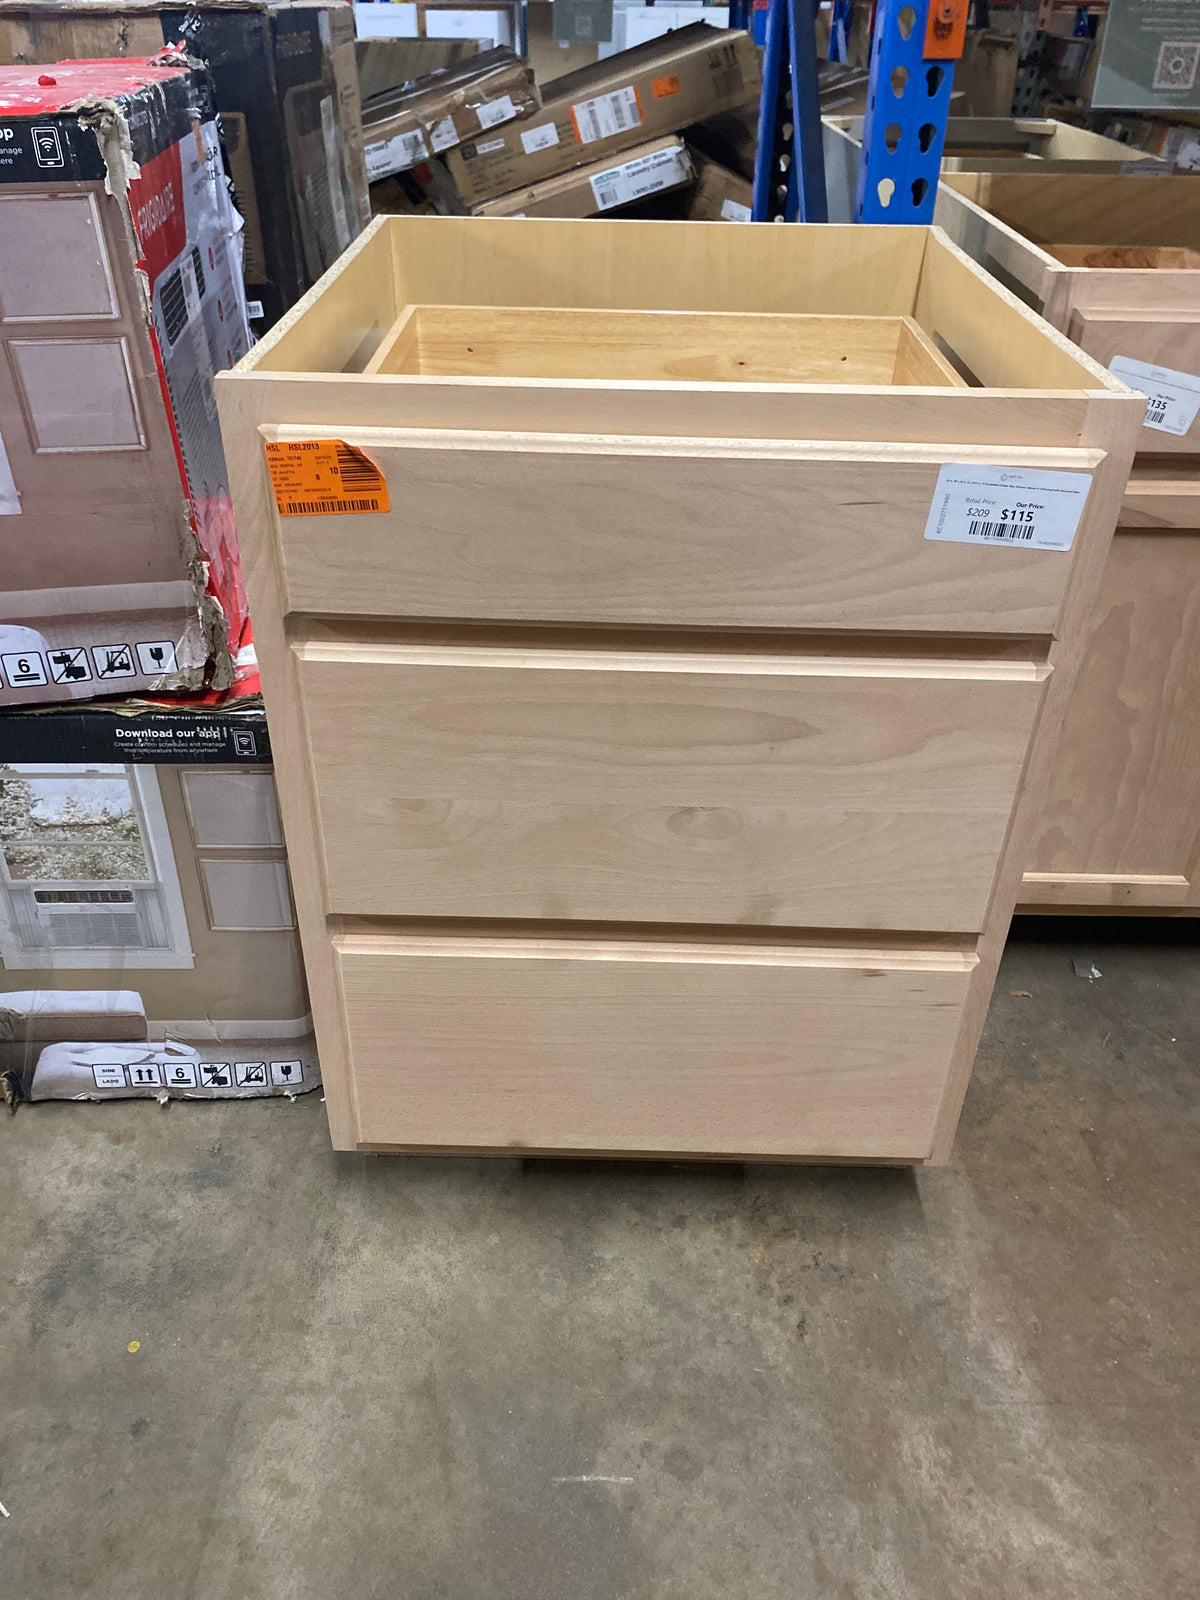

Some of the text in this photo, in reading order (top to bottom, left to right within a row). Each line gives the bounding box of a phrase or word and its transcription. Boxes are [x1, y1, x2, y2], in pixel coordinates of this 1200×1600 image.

[265, 443, 320, 452] HSL HSL2013
[329, 466, 339, 475] 10
[965, 497, 981, 505] Retail
[1028, 502, 1045, 510] Price:
[966, 507, 991, 518] $209
[1000, 508, 1035, 523] $115
[17, 658, 31, 674] 6
[115, 728, 173, 738] Download
[176, 730, 196, 738] our
[175, 1067, 185, 1079] 6
